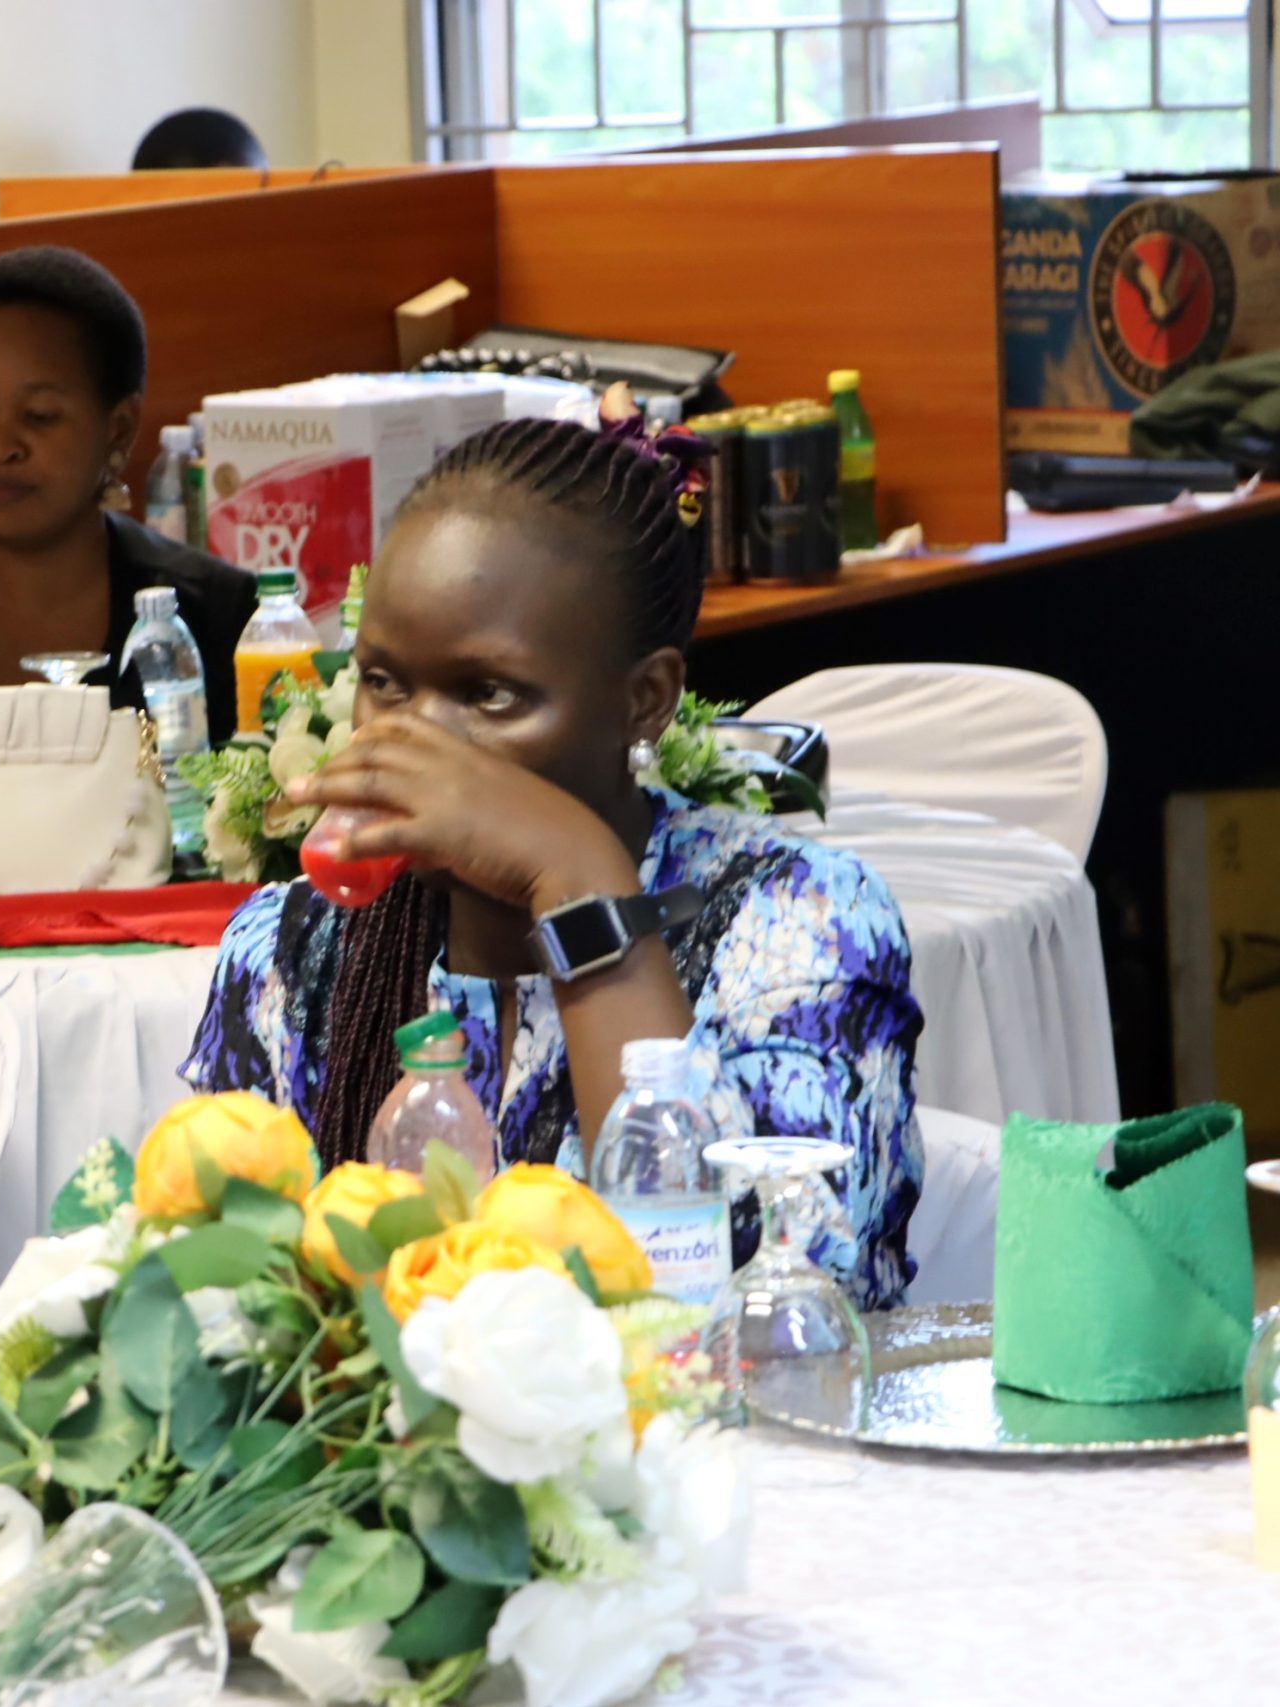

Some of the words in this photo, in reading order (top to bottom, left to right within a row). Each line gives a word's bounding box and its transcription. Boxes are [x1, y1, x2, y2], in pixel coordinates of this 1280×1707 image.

[1002, 230, 1083, 260] GANDA
[1003, 263, 1079, 292] ARAGI
[211, 420, 333, 448] NAMAQUA
[236, 524, 310, 570] DRY
